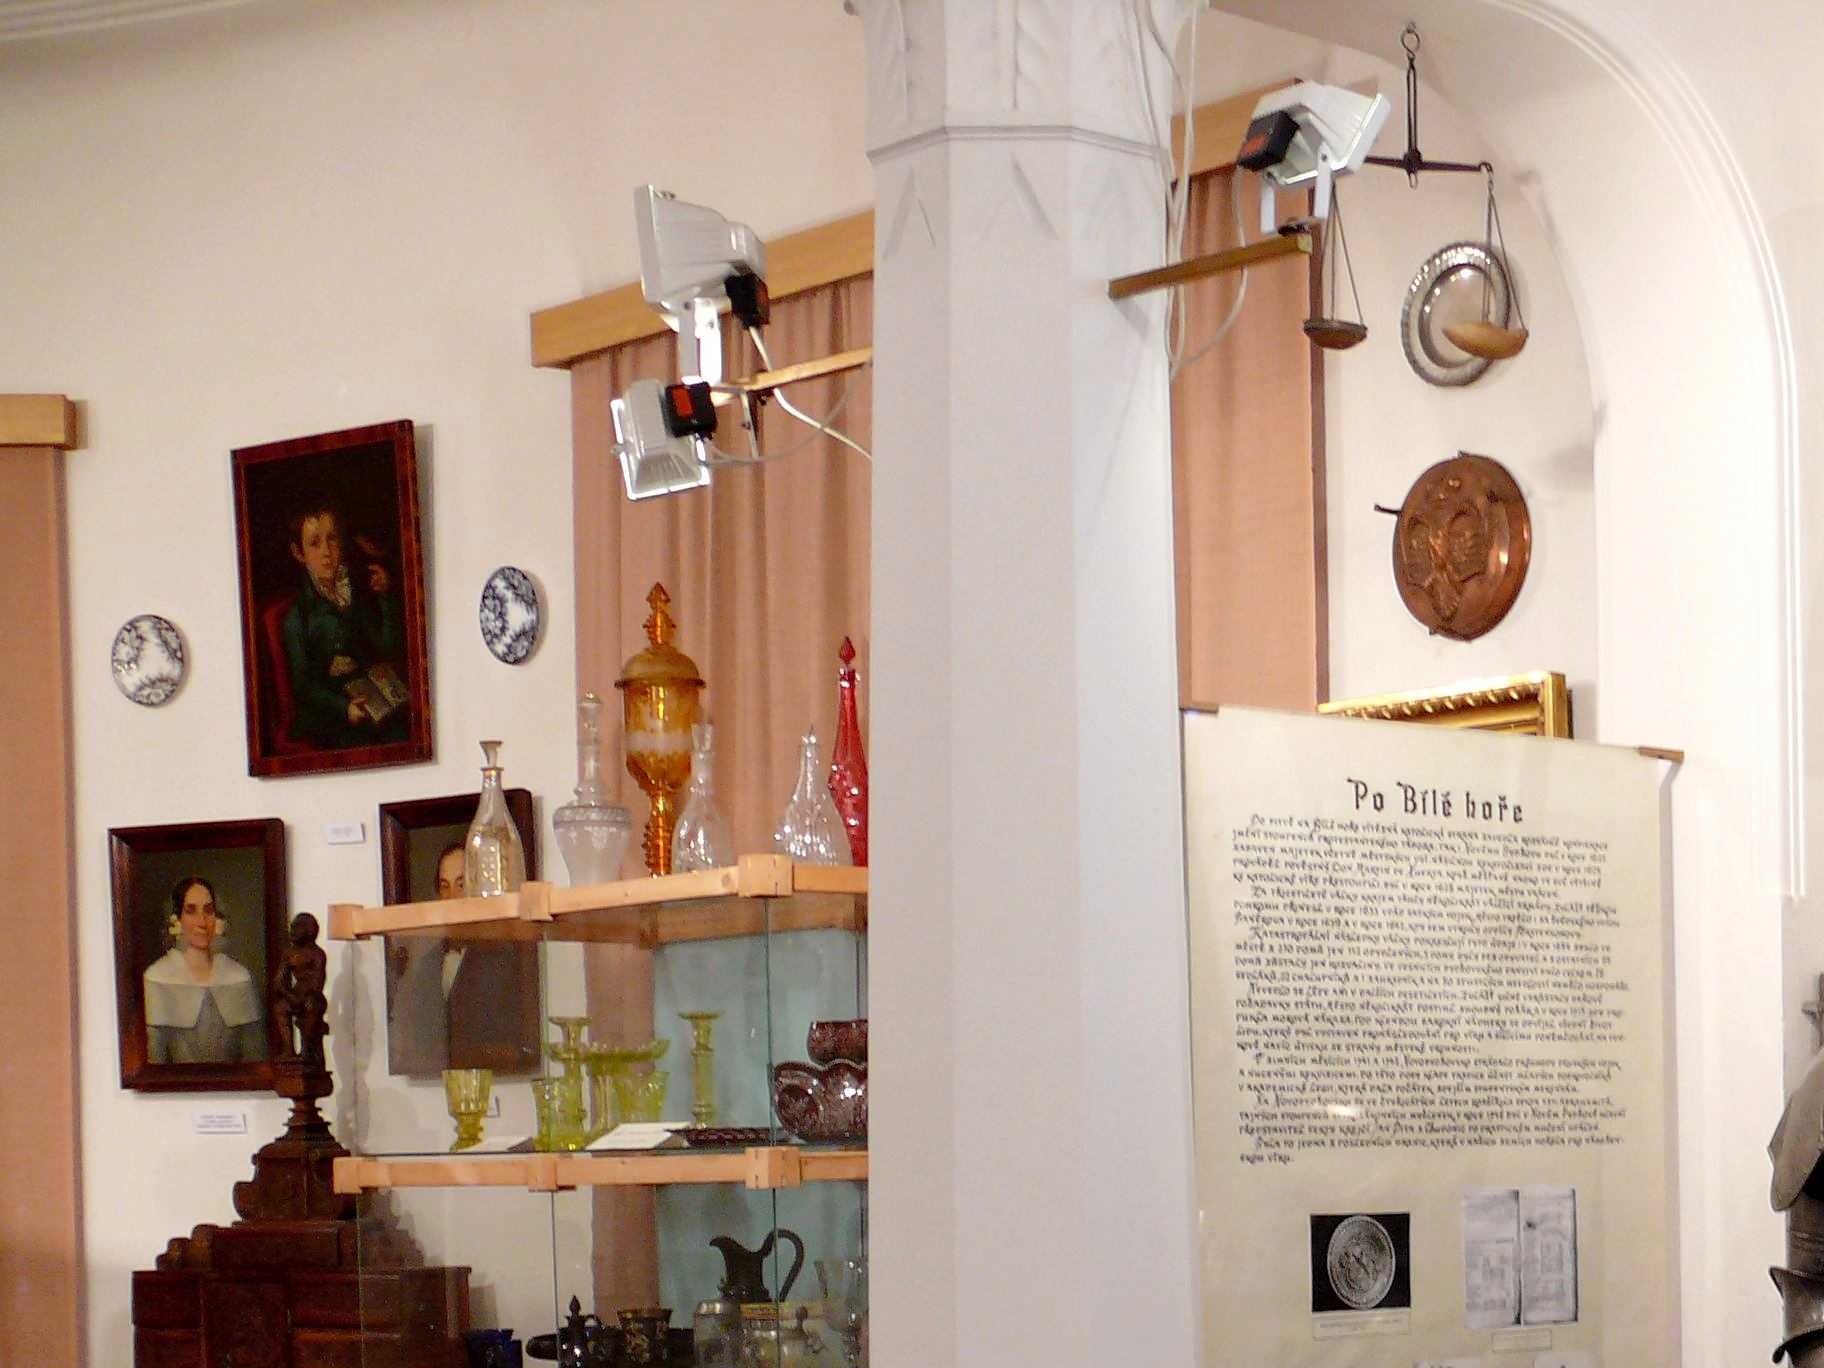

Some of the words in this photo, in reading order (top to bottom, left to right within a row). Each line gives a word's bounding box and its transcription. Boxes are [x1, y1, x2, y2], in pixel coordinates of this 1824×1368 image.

[1347, 777, 1384, 812] Po
[1396, 781, 1452, 818] Bílé
[1466, 790, 1523, 823] hoře
